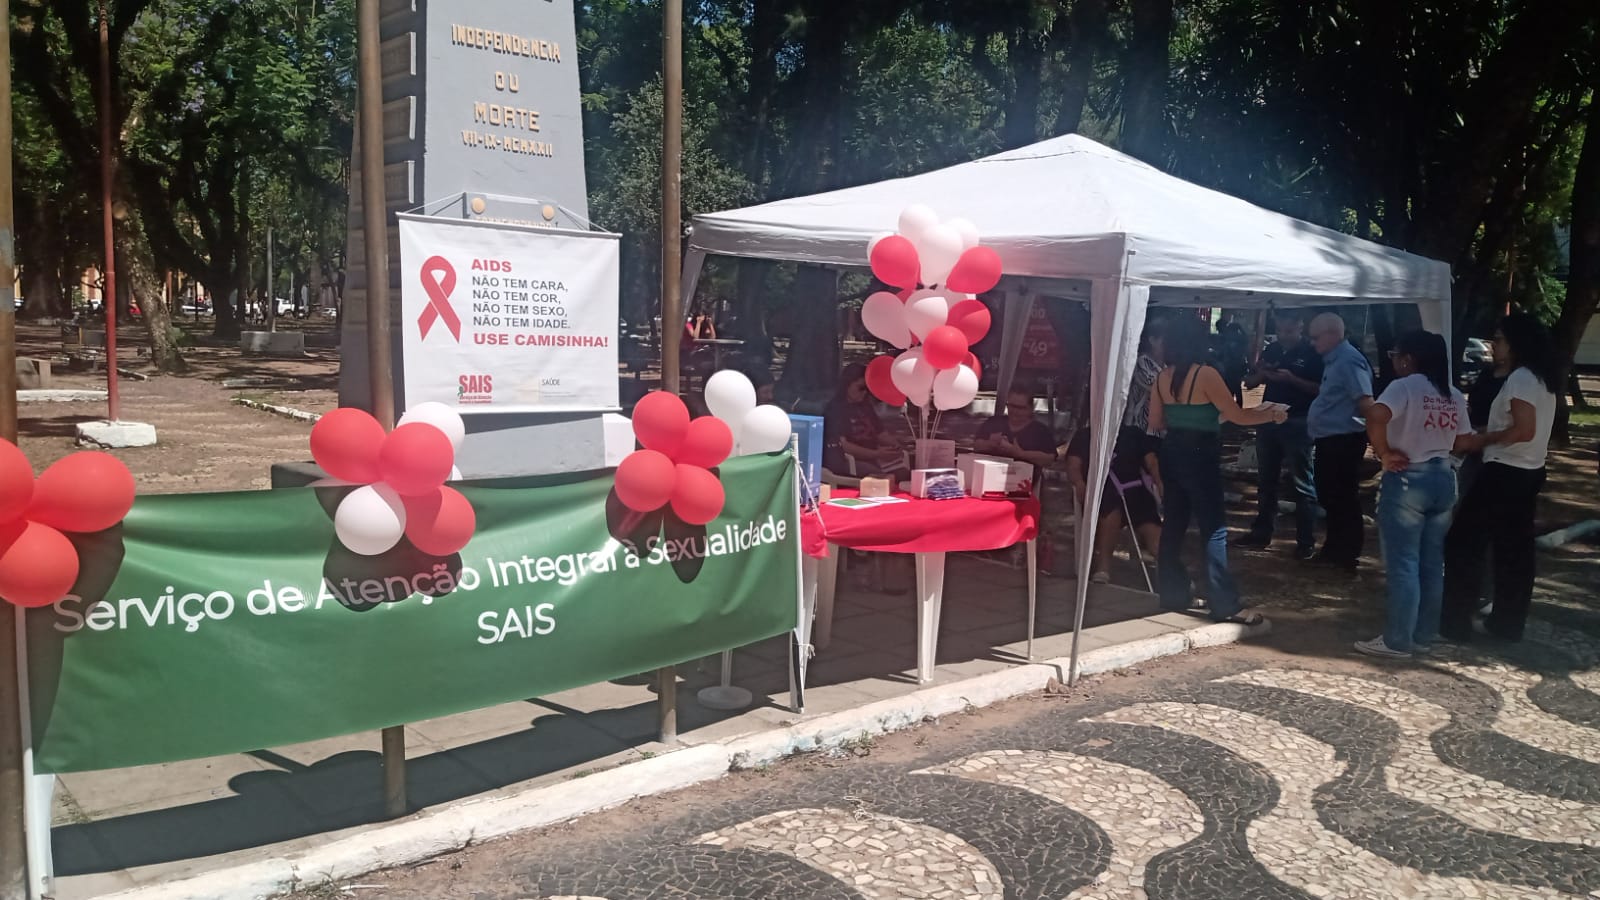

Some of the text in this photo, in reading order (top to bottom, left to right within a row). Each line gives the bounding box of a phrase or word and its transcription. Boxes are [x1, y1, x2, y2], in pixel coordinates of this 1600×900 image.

[494, 71, 520, 92] OU
[474, 101, 540, 132] MORTE
[471, 258, 512, 273] AIDS
[471, 275, 569, 292] NÃO TEM CARA,
[472, 288, 561, 304] NÃO TEM COR,
[473, 301, 568, 318] NÃO TEM SEXO,
[473, 314, 571, 329] NÃO TEM IDADE.
[473, 333, 609, 348] USE CAMISINHA!
[459, 374, 493, 394] SAIS
[52, 514, 787, 632] Serviço de Atenção Integral à Sexualidade
[477, 603, 556, 645] SAIS
